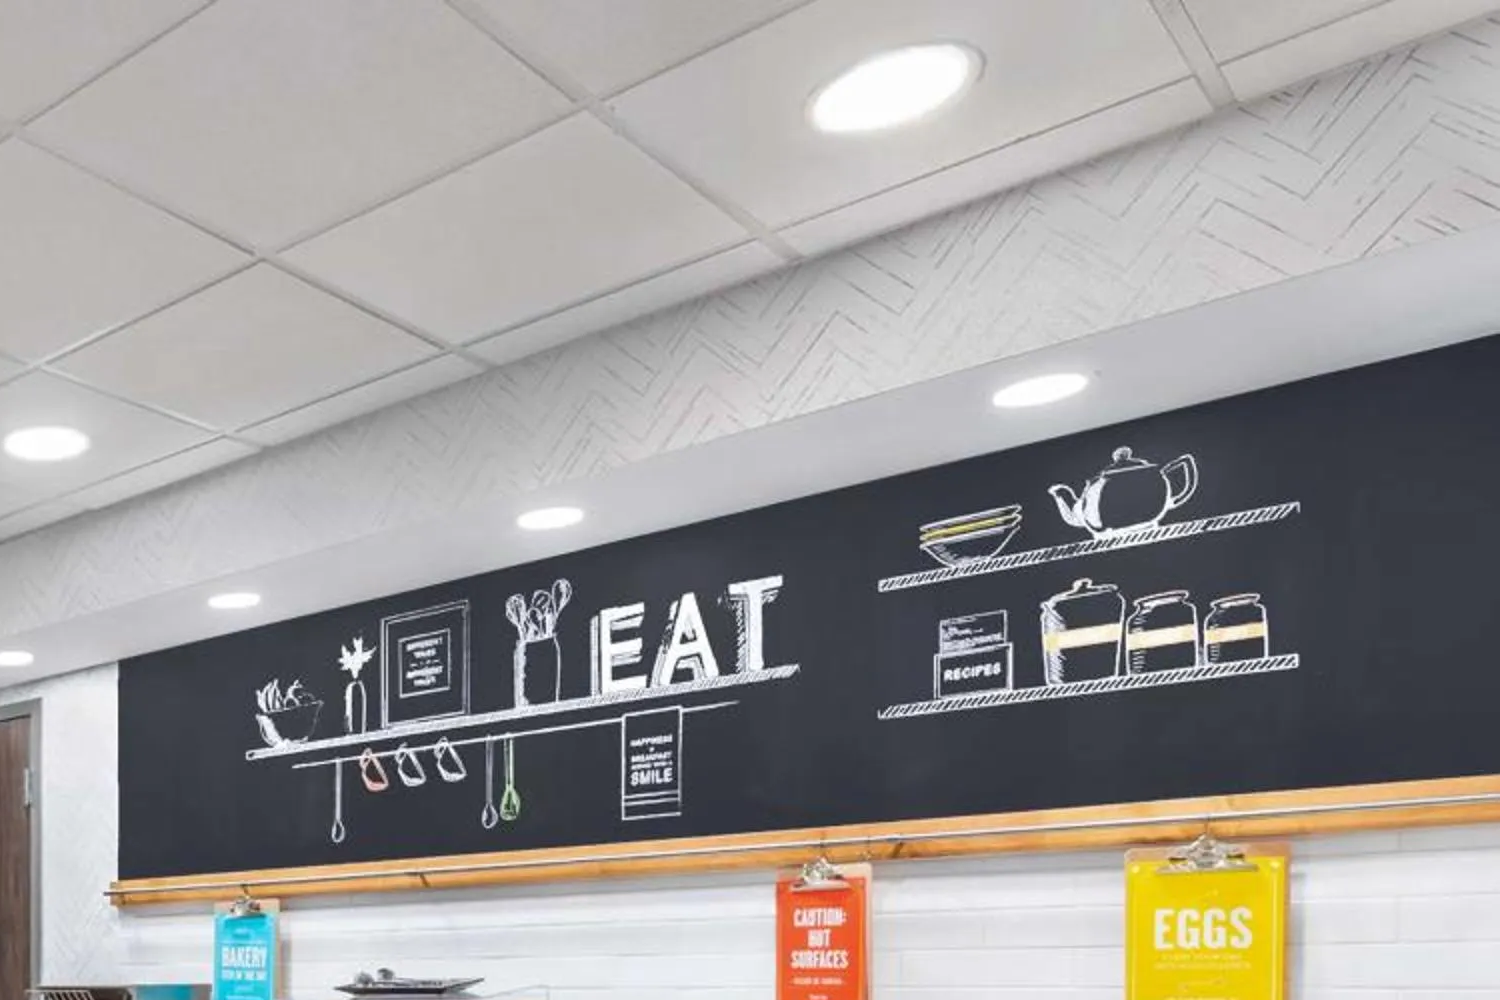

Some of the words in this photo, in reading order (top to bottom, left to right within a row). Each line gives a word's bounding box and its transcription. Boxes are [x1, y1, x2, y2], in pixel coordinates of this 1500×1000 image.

[590, 575, 784, 697] EAT
[943, 661, 1001, 682] RECIPES
[630, 767, 673, 787] SMILE
[793, 907, 848, 928] CAUTION:
[1154, 906, 1253, 950] EGGS
[807, 928, 832, 948] HOT
[221, 946, 268, 969] BAKERY
[790, 949, 849, 969] SURFACES
